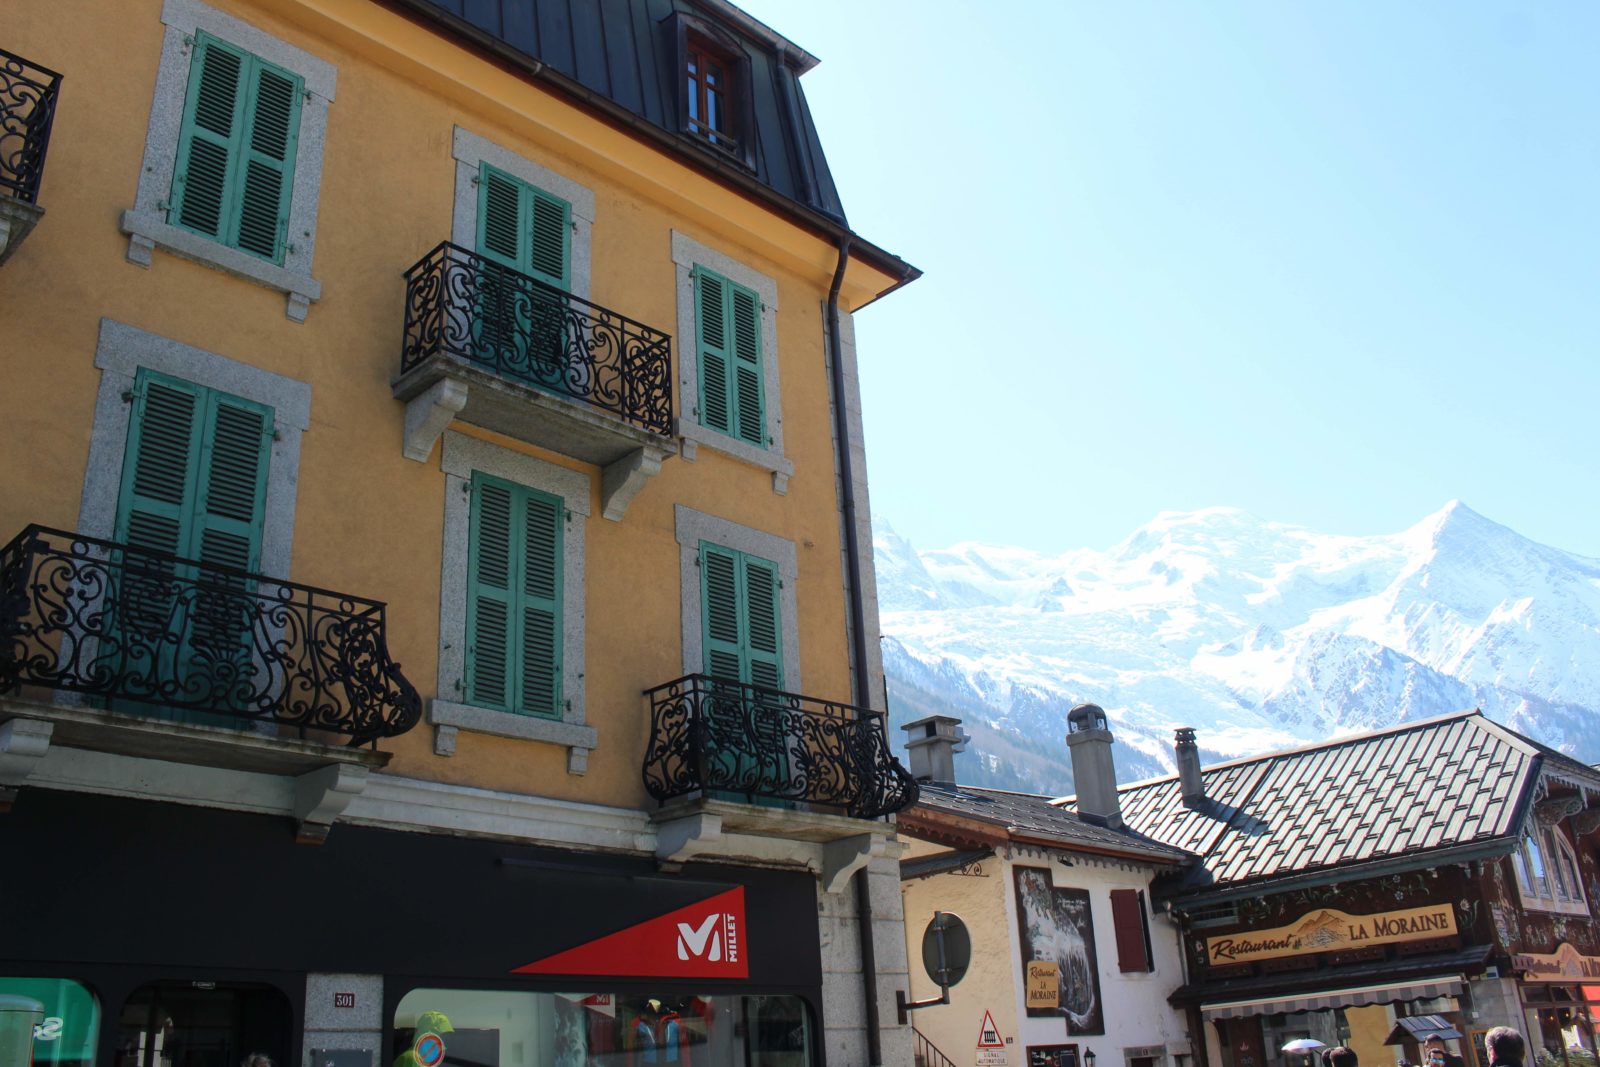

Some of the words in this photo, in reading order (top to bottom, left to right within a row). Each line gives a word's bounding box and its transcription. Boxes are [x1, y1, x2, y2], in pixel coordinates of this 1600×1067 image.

[727, 913, 738, 963] MILLET
[1211, 933, 1296, 960] Restaurant
[1348, 924, 1369, 940] LA
[1373, 913, 1449, 938] MORAINE
[1030, 966, 1057, 979] Restaurant
[336, 995, 352, 1006] 301
